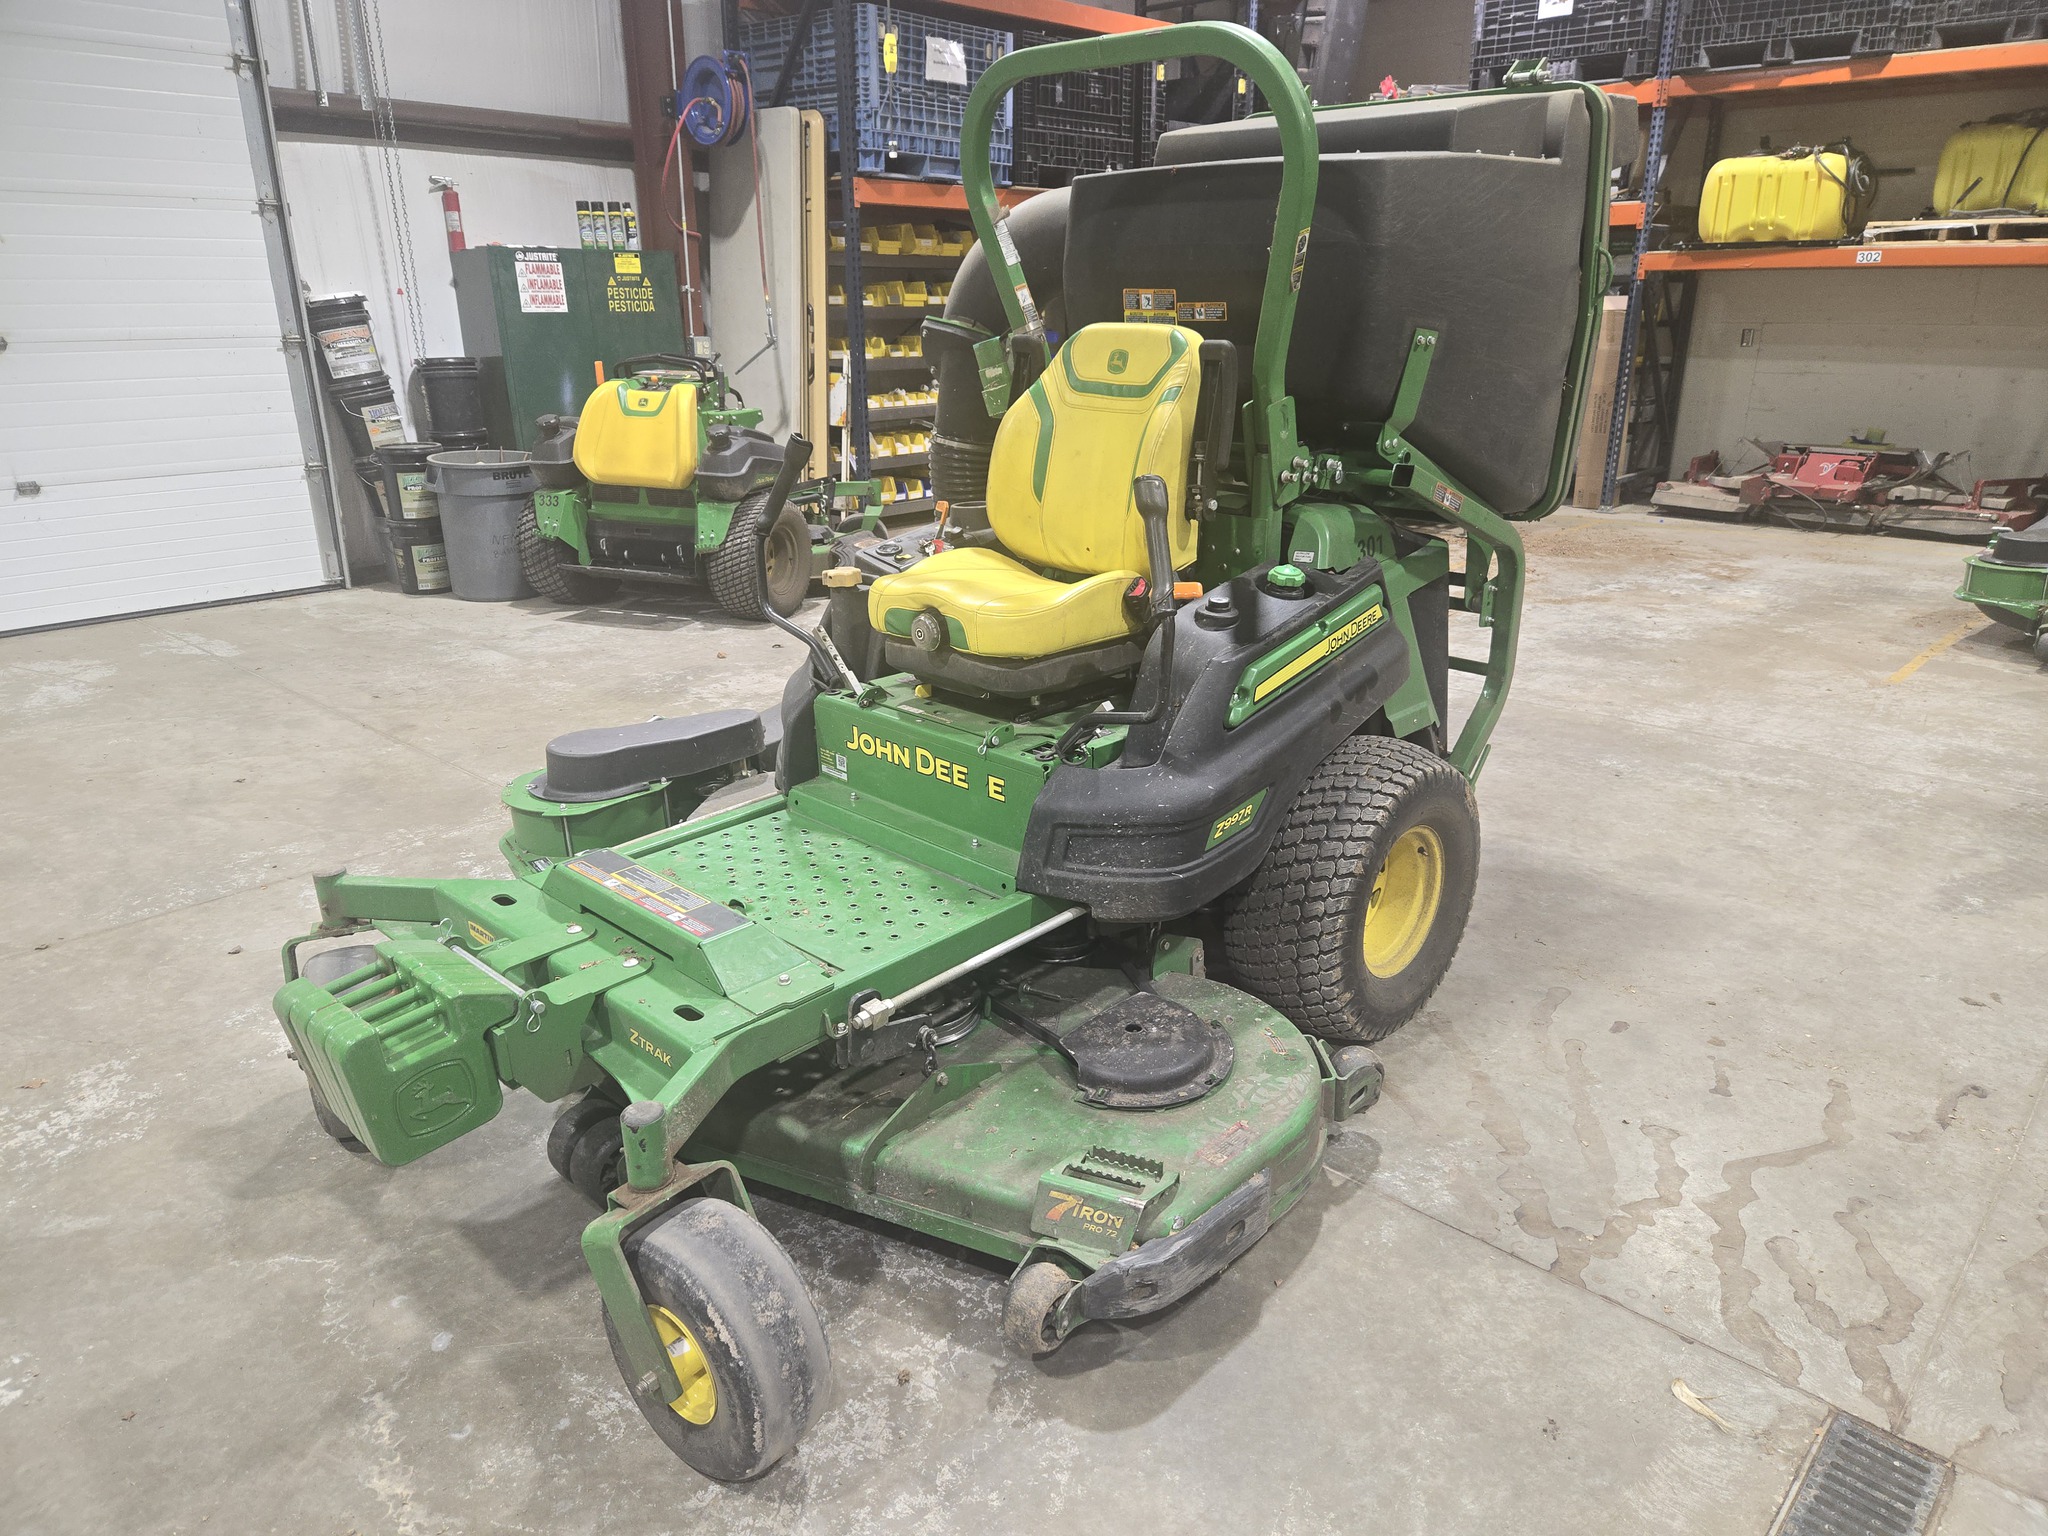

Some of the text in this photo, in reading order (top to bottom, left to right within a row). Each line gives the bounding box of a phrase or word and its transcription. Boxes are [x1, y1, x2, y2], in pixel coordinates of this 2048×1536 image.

[525, 252, 558, 261] JUSTRITE
[1858, 252, 1880, 262] 302
[525, 263, 560, 275] FLAMMABLE
[607, 287, 654, 299] PESTICIDE
[608, 300, 656, 312] PESTICIDA
[493, 471, 530, 480] BRUTE
[539, 495, 559, 507] 333
[1357, 534, 1383, 561] 301
[1325, 610, 1377, 655] JOHN DEERE
[846, 725, 911, 769] JOHN
[1214, 804, 1253, 839] Z997R
[629, 1027, 673, 1068] ZTRAK
[1083, 1222, 1118, 1238] PRO 72
